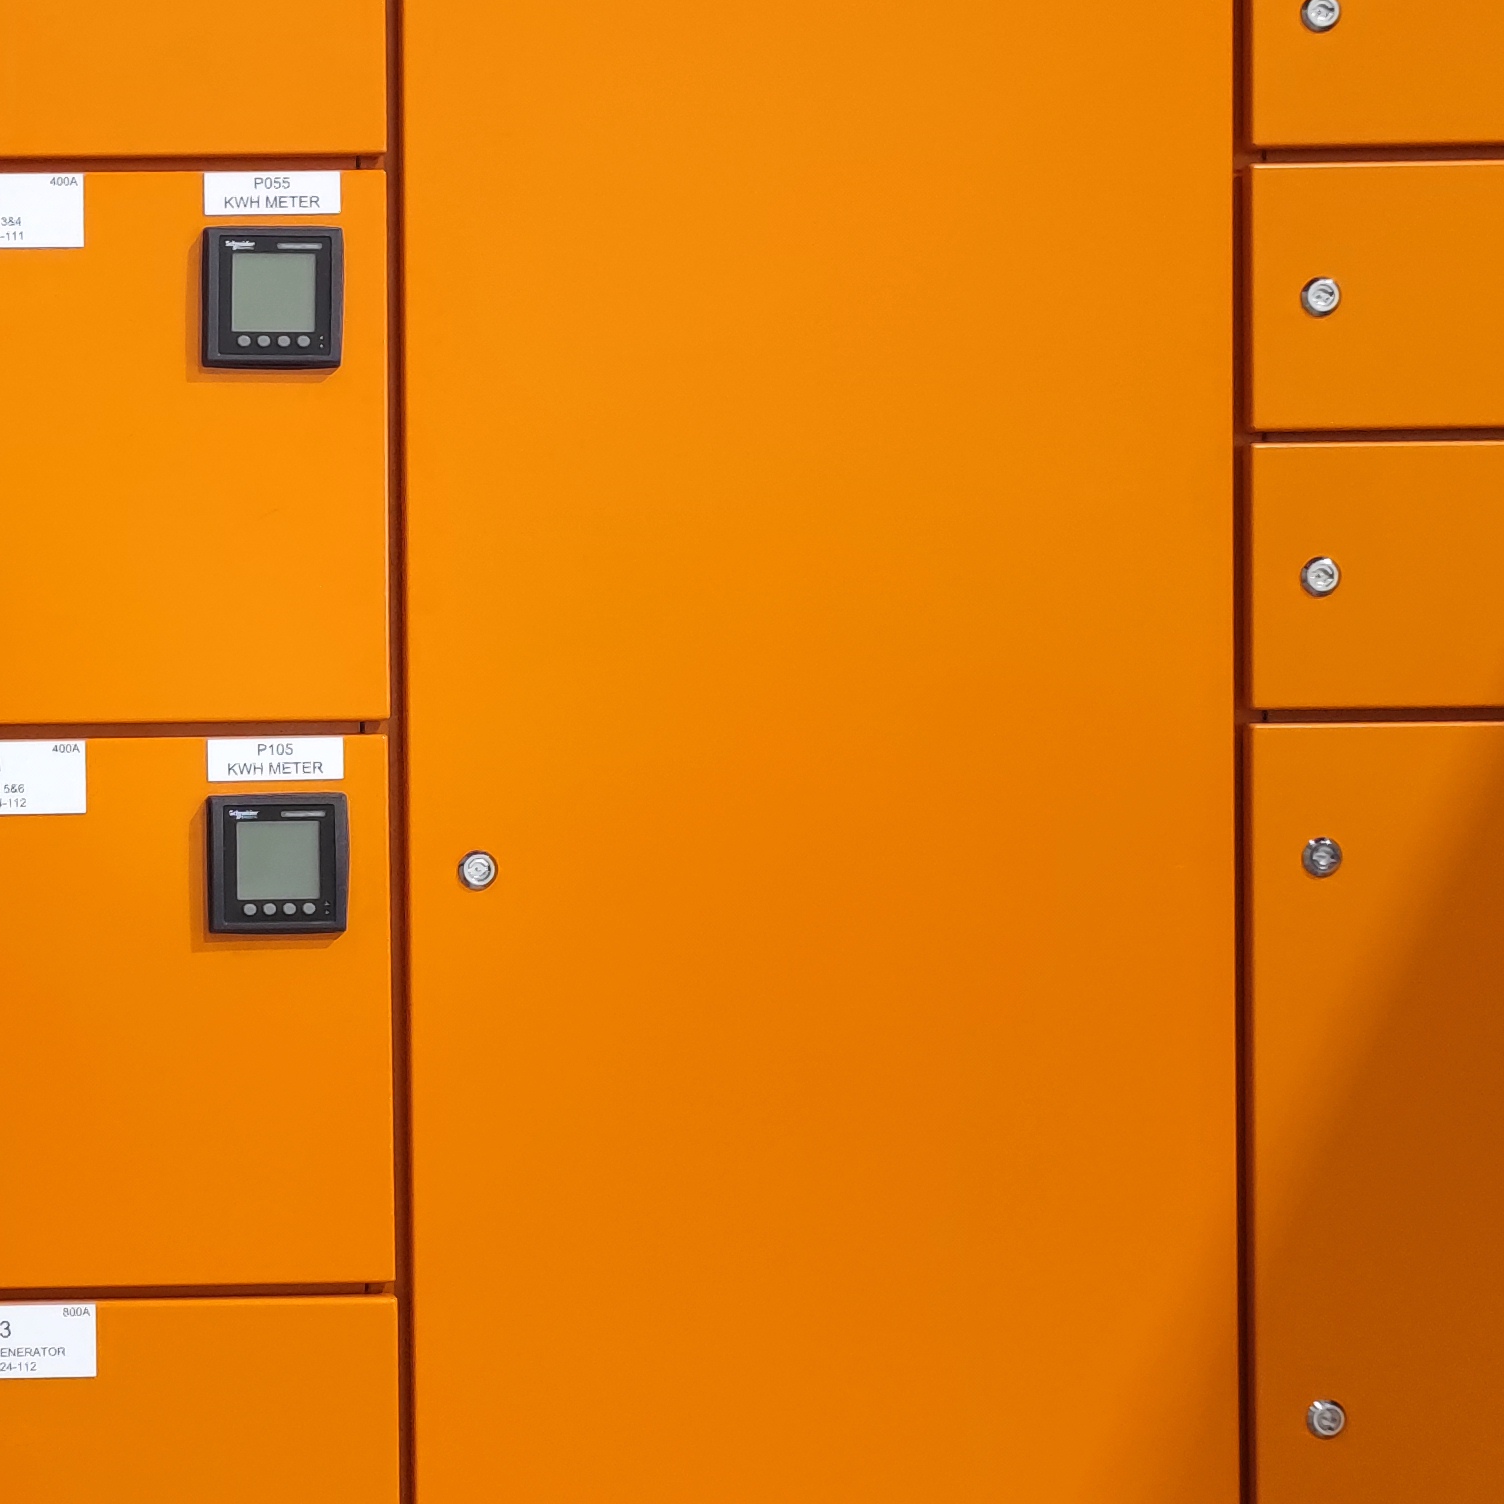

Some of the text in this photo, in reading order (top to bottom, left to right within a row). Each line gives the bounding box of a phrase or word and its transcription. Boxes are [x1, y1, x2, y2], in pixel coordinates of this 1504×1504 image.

[49, 177, 79, 187] 400A
[253, 177, 291, 190] P055
[224, 195, 321, 209] KWH METER
[0, 217, 22, 227] 3&4
[52, 744, 81, 754] 400A
[257, 743, 294, 756] P105
[227, 761, 324, 776] KWH METER
[3, 784, 25, 794] 5&6
